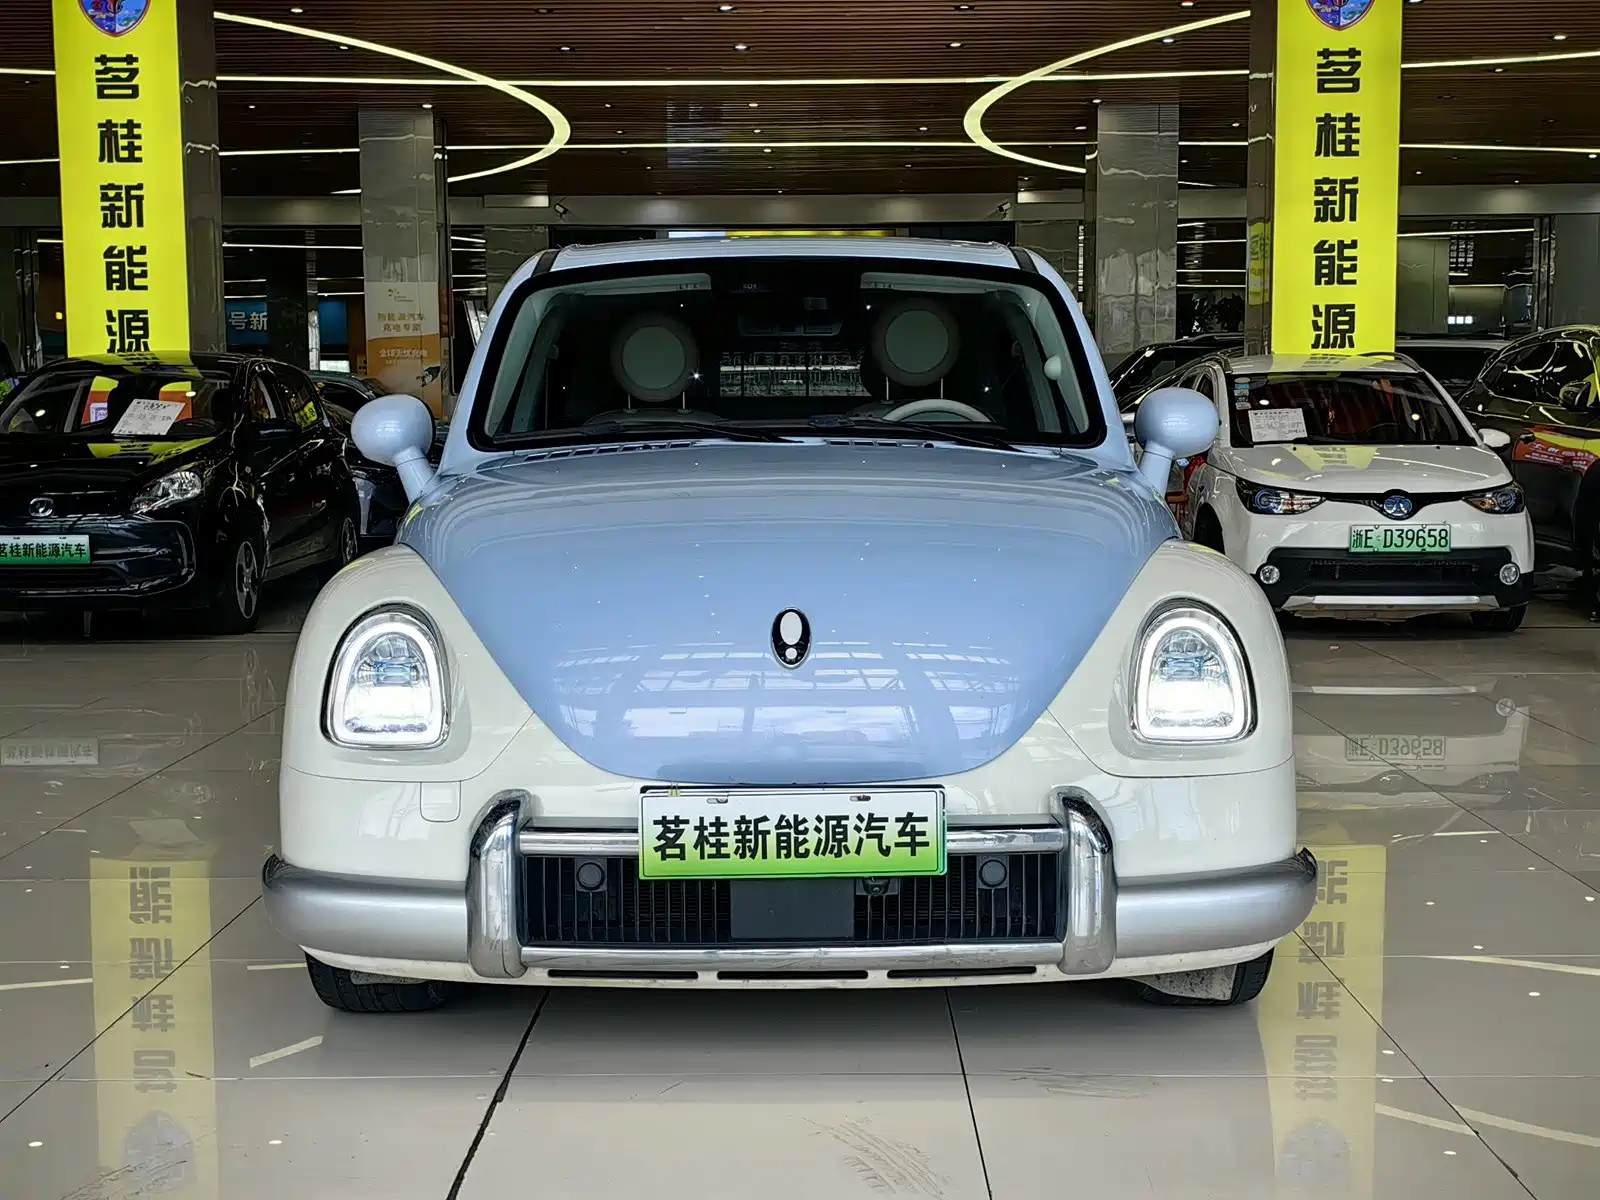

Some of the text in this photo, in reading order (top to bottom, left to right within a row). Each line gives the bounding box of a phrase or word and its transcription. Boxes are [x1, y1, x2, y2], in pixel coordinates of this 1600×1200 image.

[94, 53, 150, 353] 茗桂新能源
[1312, 47, 1362, 350] 茗桂新能源
[0, 542, 87, 559] 茗桂新能源汽车
[652, 811, 931, 861] 茗桂新能源汽车
